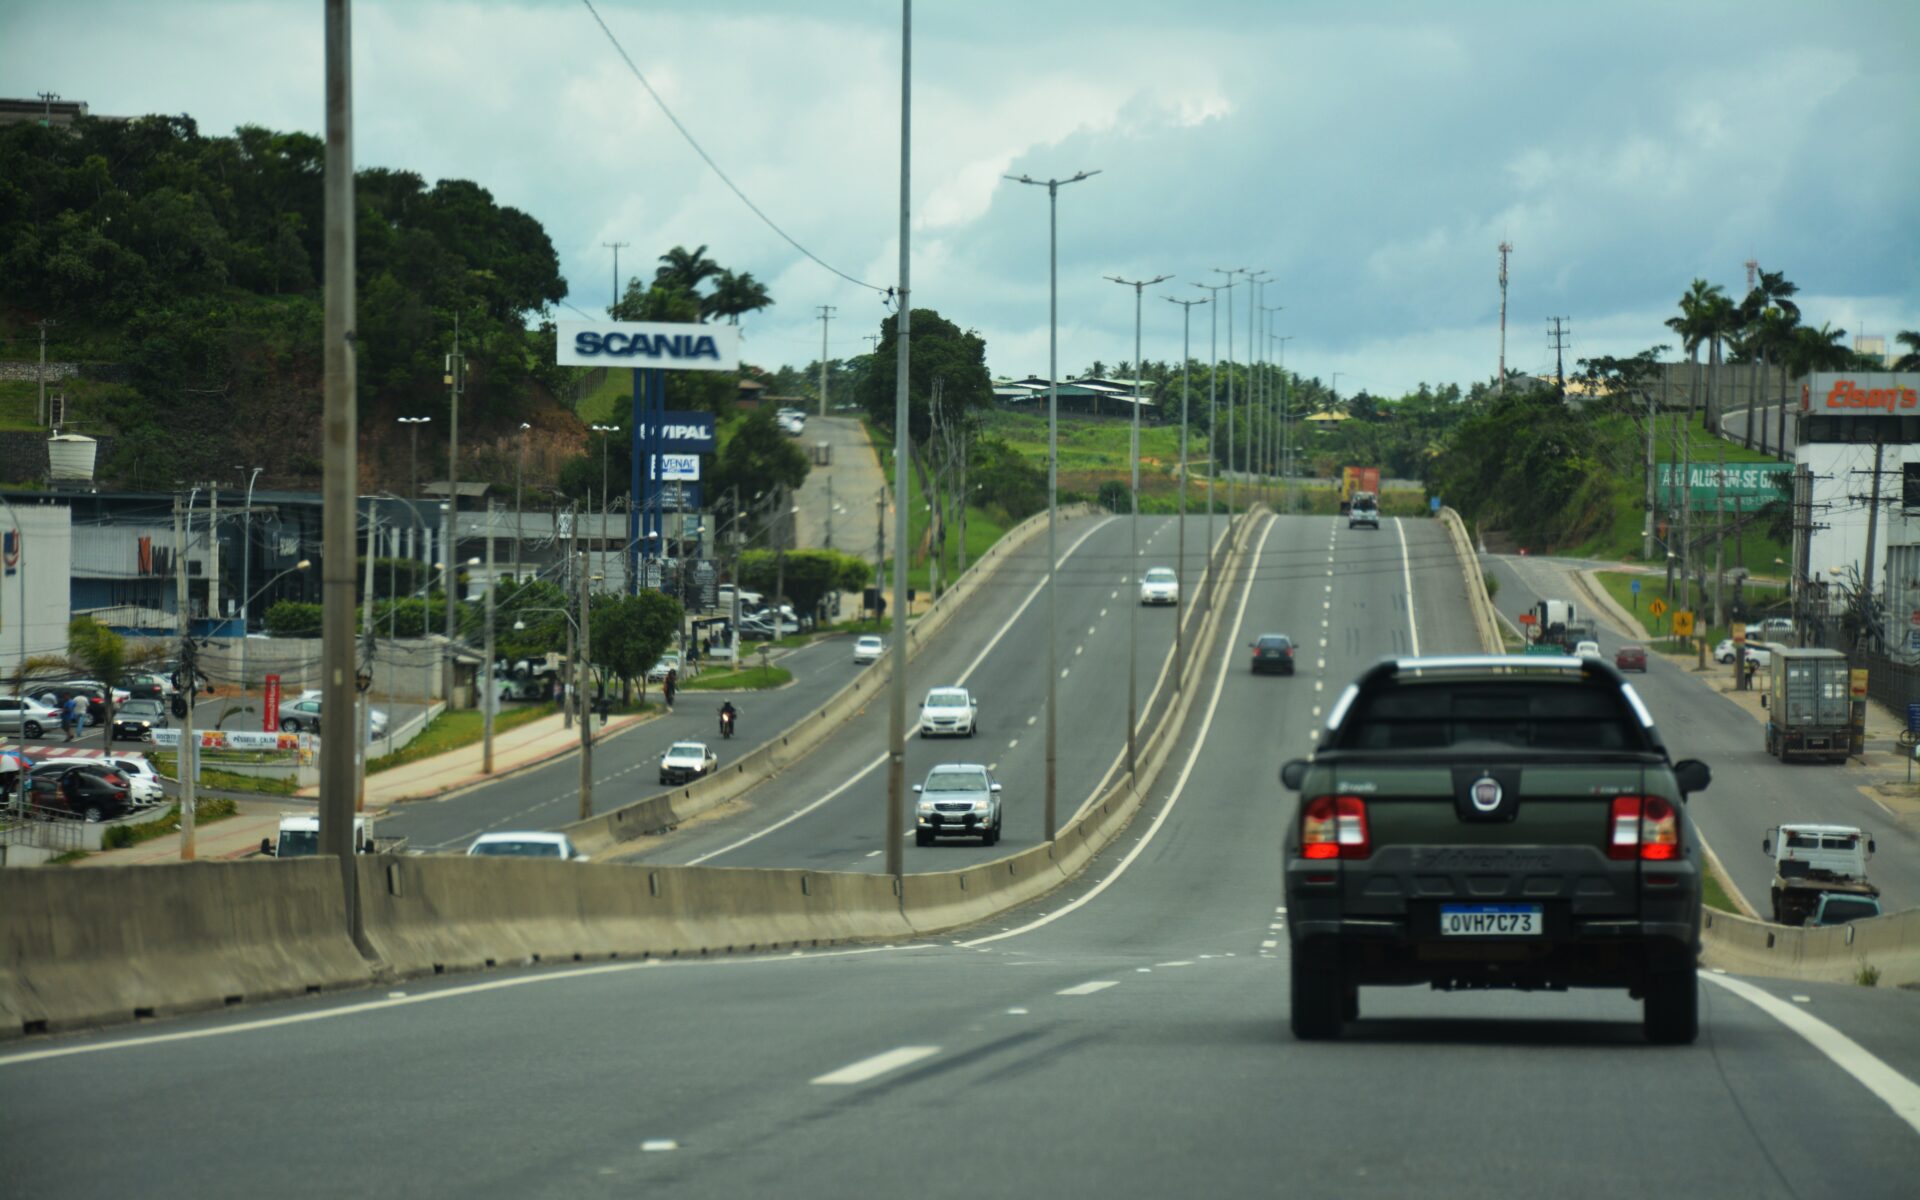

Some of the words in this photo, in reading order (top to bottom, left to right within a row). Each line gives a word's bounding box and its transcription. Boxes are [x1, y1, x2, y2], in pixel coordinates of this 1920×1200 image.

[575, 331, 720, 360] SCANIA
[1826, 379, 1917, 413] Elson's
[1450, 914, 1532, 932] OVH7C73
